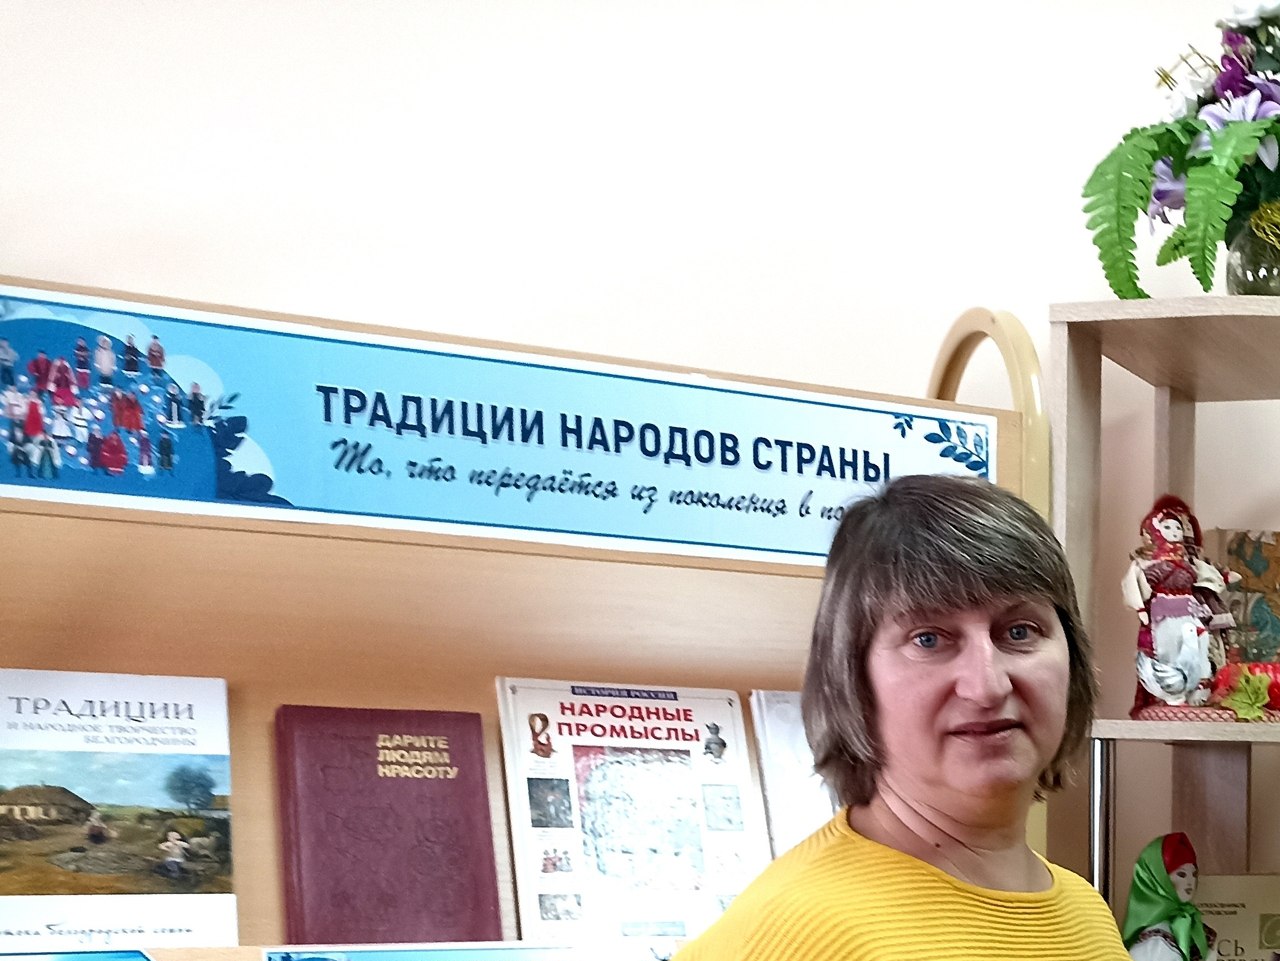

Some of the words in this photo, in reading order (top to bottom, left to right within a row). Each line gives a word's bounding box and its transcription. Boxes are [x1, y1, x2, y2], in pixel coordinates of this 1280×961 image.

[315, 385, 544, 445] ТРАДИЦИИ
[560, 413, 740, 467] НАРОДОВ
[752, 436, 890, 482] СТРАНЫ
[330, 437, 392, 480] То,
[406, 457, 456, 482] что
[469, 467, 619, 502] передаётся
[630, 484, 658, 514] из
[669, 488, 787, 518] поколения
[799, 489, 813, 518] в
[8, 696, 194, 722] ТРАДИЦИИ
[559, 702, 694, 722] НАРОДНЫЕ
[376, 734, 449, 749] ДАРИТЕ
[557, 722, 701, 742] ПРОМЫСЛЫ
[377, 749, 450, 764] ЛЮДЯМ
[377, 764, 459, 779] КРАСОТУ
[1217, 939, 1245, 957] СЬ
